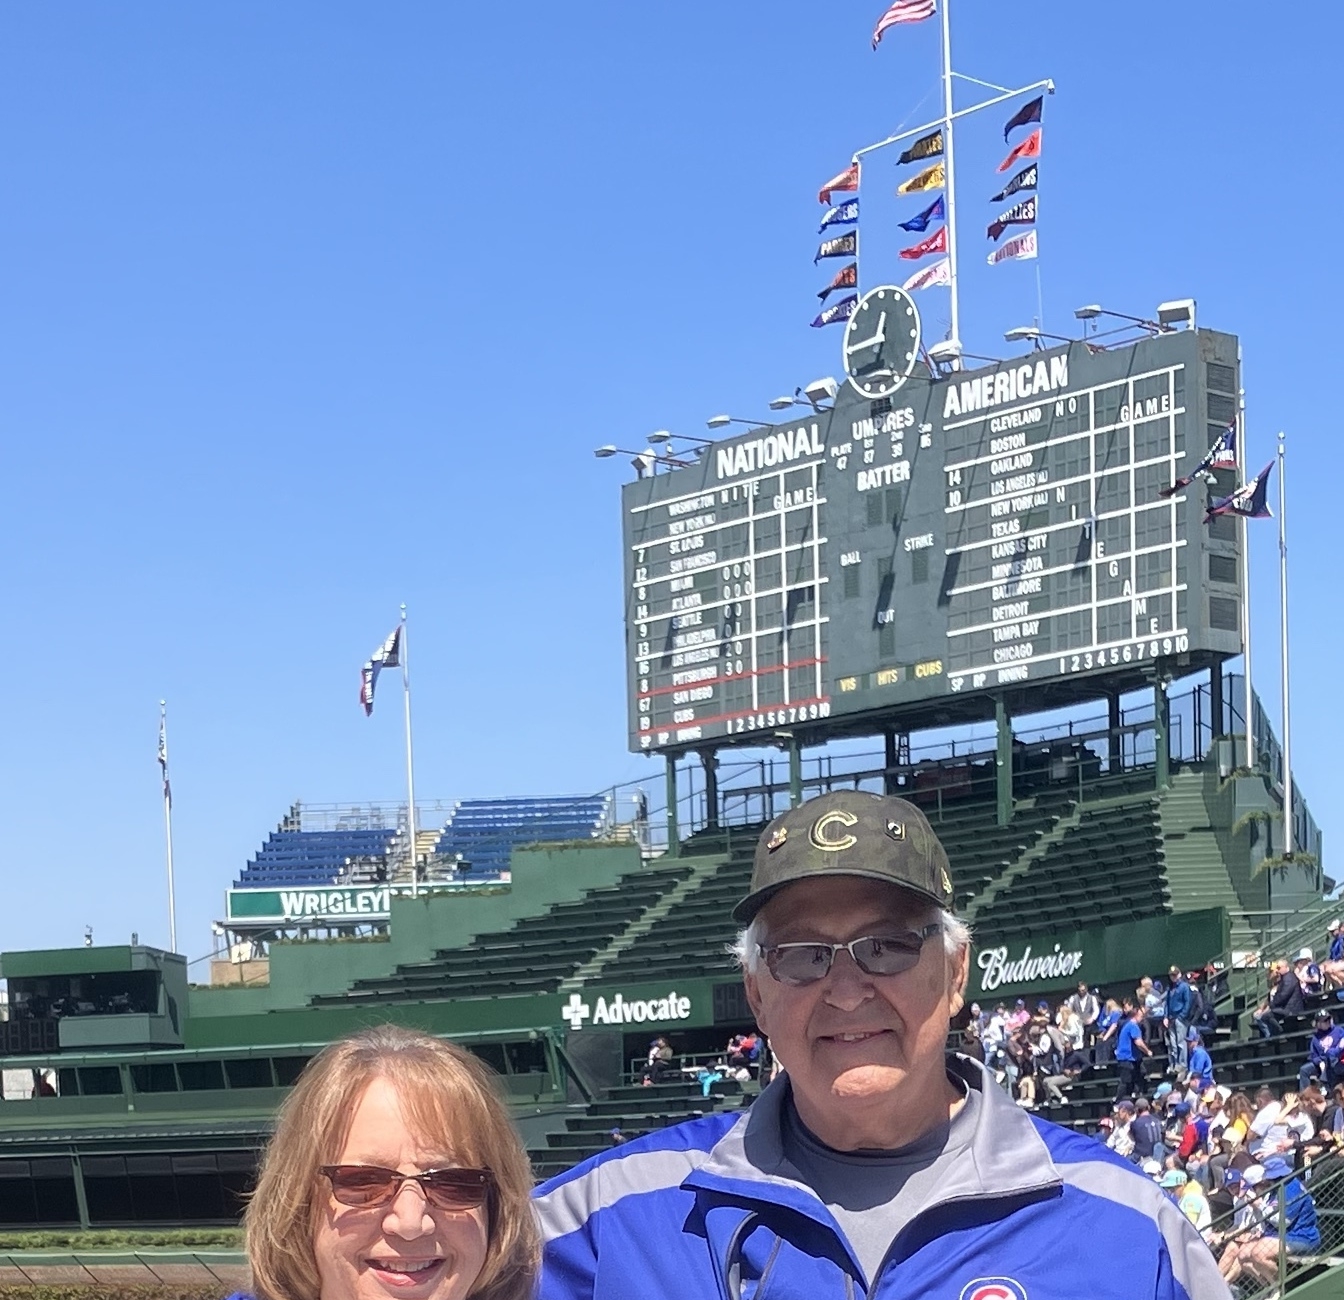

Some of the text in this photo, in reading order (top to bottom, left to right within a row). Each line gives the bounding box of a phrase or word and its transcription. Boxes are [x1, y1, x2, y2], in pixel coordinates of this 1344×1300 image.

[942, 354, 1069, 418] AMERICAN
[991, 408, 1041, 433] CLEVELAND
[717, 424, 825, 479] NATIONAL
[991, 433, 1026, 454] BOSTON
[991, 453, 1033, 475] OAKLAND
[857, 460, 910, 491] BATTER
[991, 480, 1004, 495] LOS
[1005, 473, 1035, 492] ANGELES
[991, 501, 1010, 517] NEW
[1012, 496, 1034, 513] YORK
[992, 519, 1020, 537] TEXAS
[904, 533, 935, 552] STRIKE
[992, 534, 1047, 559] KANSAS CITY
[840, 551, 861, 567] BALL
[992, 556, 1043, 579] MINNESOTA
[992, 578, 1042, 601] BALTIMORE
[877, 609, 895, 624] OUT
[992, 601, 1029, 622] DETROIT
[992, 620, 1040, 642] TAMPA BAY
[993, 642, 1033, 663] CHICAGO
[840, 660, 943, 692] VIS HITS CUBS
[951, 679, 964, 692] SP
[973, 673, 986, 688] RP
[998, 665, 1028, 683] INNING
[673, 690, 689, 705] SAN
[690, 685, 713, 702] DIEGO
[673, 708, 694, 724] CUBS
[808, 809, 859, 852] C
[978, 943, 1083, 991] Budweiser
[593, 991, 691, 1024] Advocate
